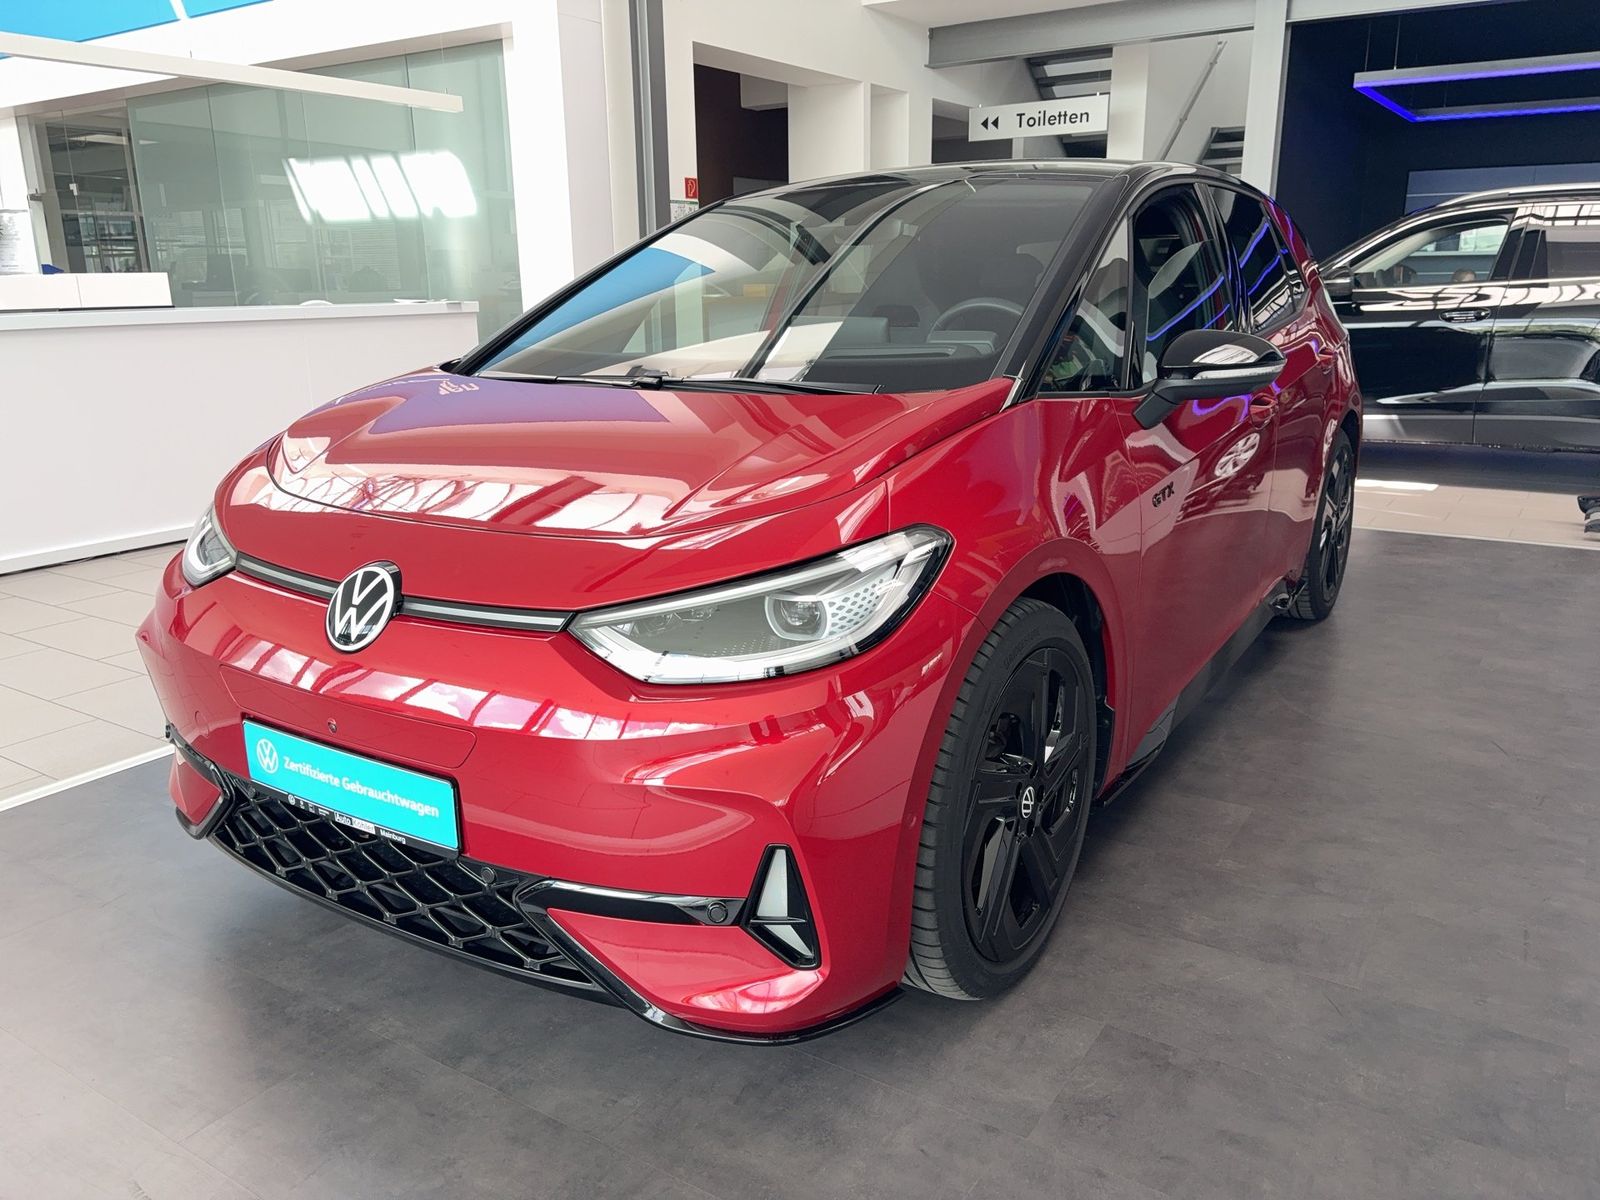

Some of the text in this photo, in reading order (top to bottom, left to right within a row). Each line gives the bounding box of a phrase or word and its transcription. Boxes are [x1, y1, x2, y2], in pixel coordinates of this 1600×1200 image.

[1016, 110, 1090, 129] Toiletten
[1152, 481, 1175, 508] GTX
[283, 756, 340, 788] Zertifizierte
[342, 777, 440, 818] Gebrauchtwagen
